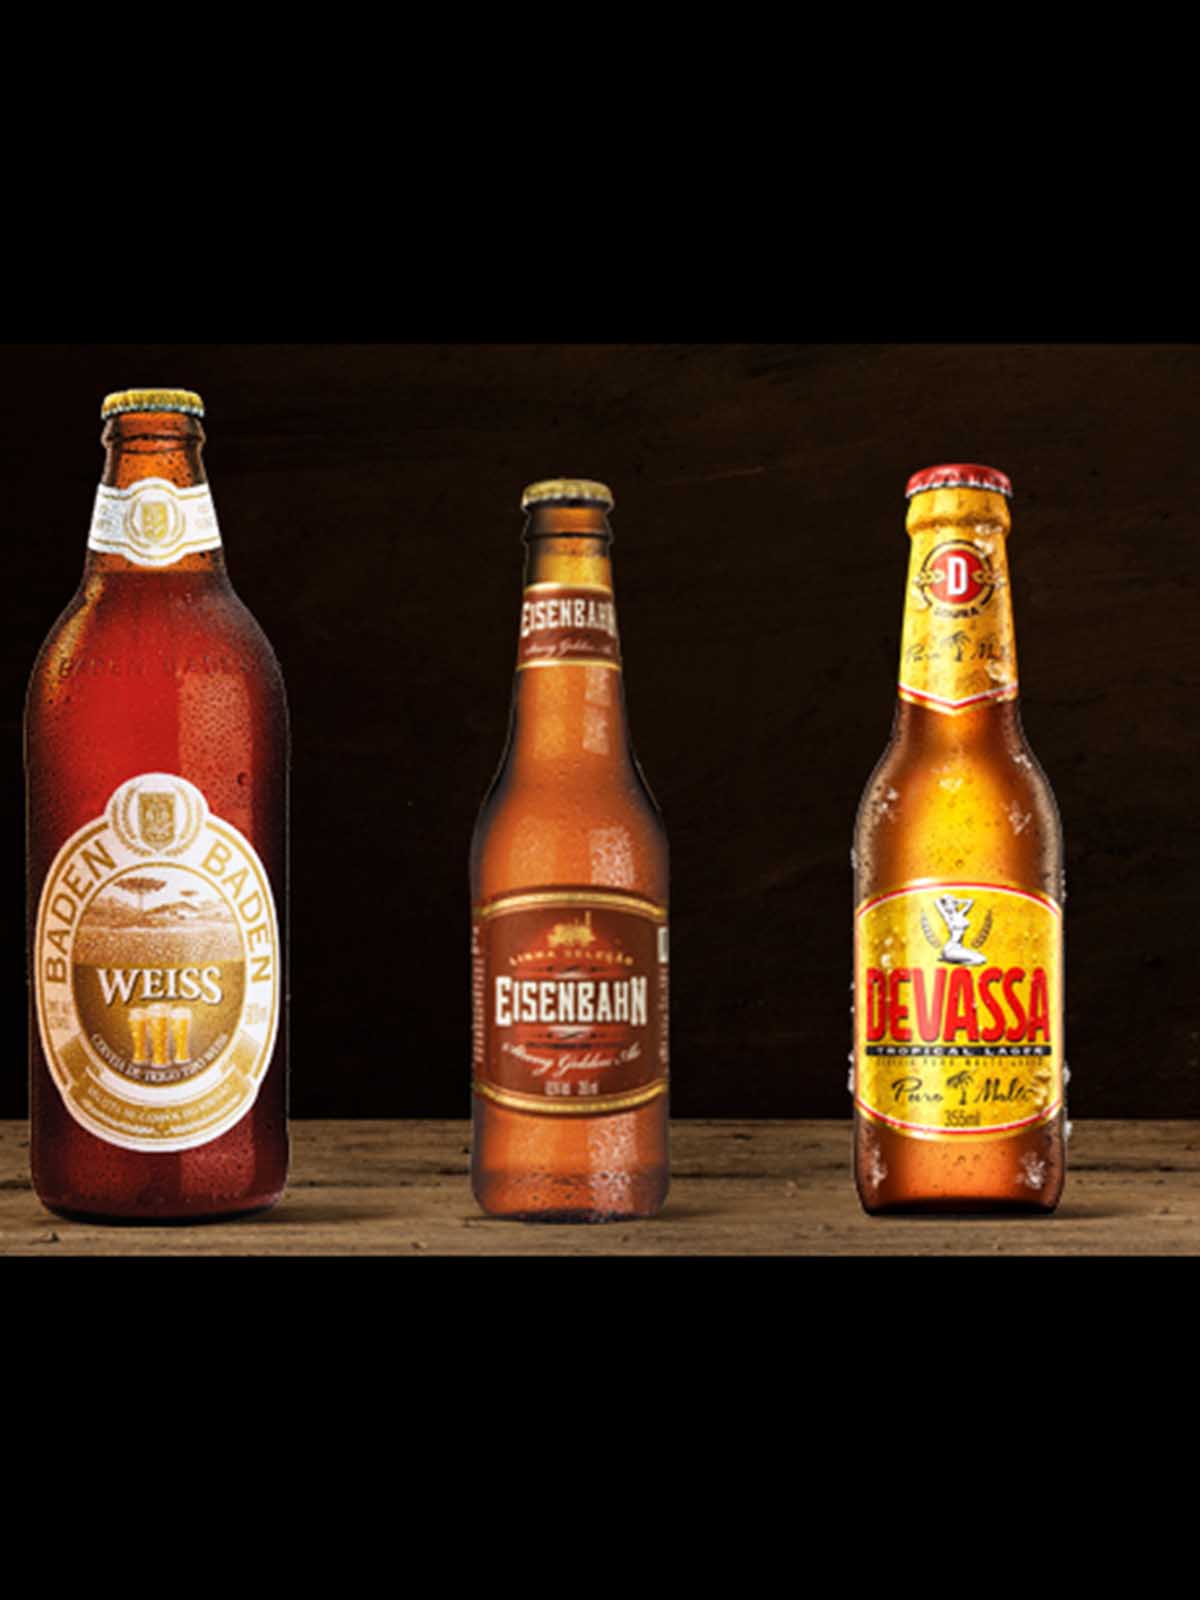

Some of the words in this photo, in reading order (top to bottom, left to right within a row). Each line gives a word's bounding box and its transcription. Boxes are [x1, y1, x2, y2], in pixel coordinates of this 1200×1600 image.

[947, 556, 968, 596] D
[521, 598, 617, 638] EISENBAHN
[46, 838, 117, 984] BADEN
[200, 839, 272, 983] BADEN
[97, 966, 223, 1006] WEISS
[495, 976, 648, 1027] EISENBAHN
[866, 966, 1051, 1042] DEVASSA
[876, 1047, 976, 1056] TROPICAL
[985, 1047, 1045, 1056] LAGER
